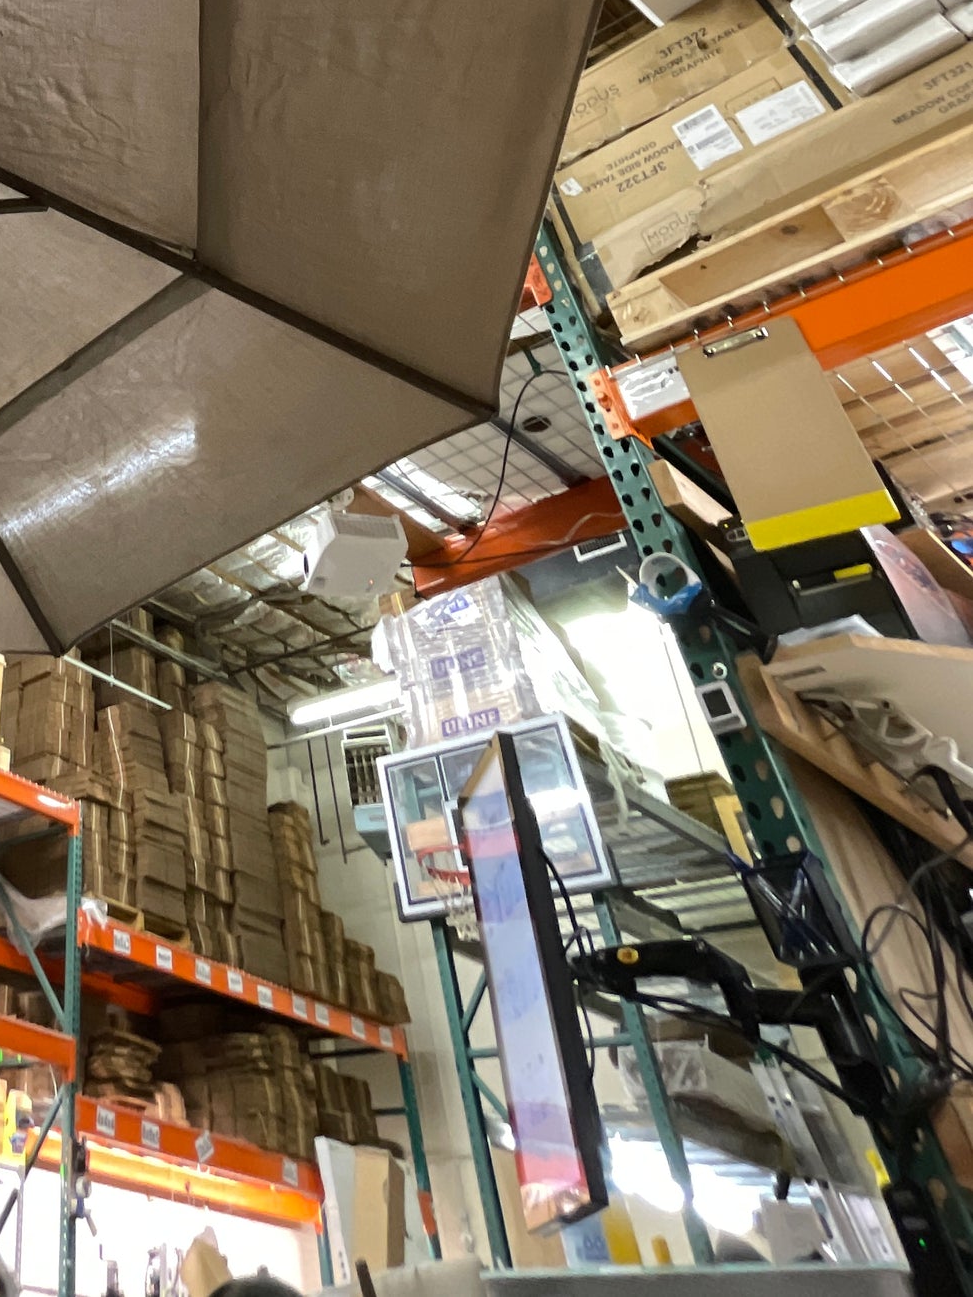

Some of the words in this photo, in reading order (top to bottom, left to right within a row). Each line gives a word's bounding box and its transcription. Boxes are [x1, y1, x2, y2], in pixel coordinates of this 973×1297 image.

[671, 47, 723, 78] GRAPHITE
[892, 95, 946, 125] MEADOW
[606, 141, 657, 171] GRAPHITE
[643, 139, 683, 165] EADOW
[616, 161, 667, 193] 3FT322
[619, 161, 642, 177] SIDE
